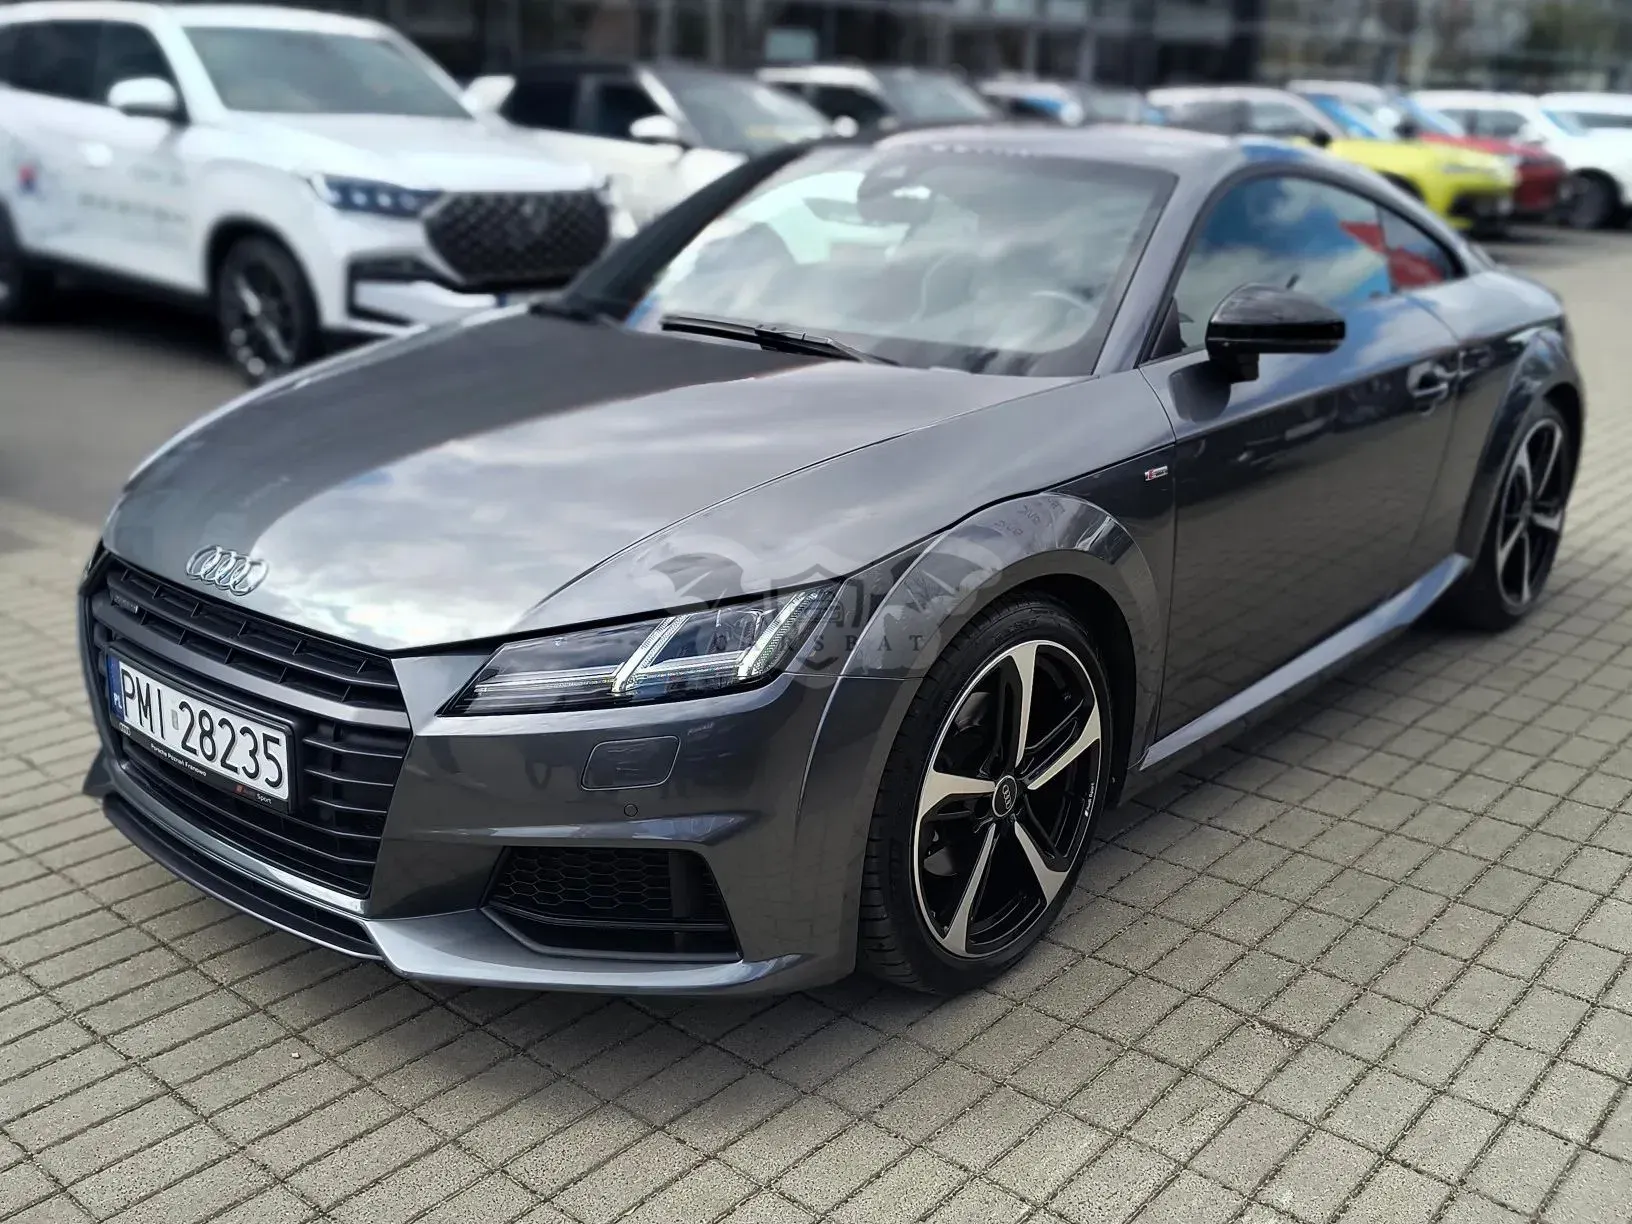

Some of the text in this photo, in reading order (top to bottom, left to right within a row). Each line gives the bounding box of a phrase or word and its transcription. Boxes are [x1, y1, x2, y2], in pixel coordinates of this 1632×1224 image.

[113, 692, 123, 710] PL
[121, 668, 284, 789] PMI 28235
[256, 793, 272, 805] Sport
